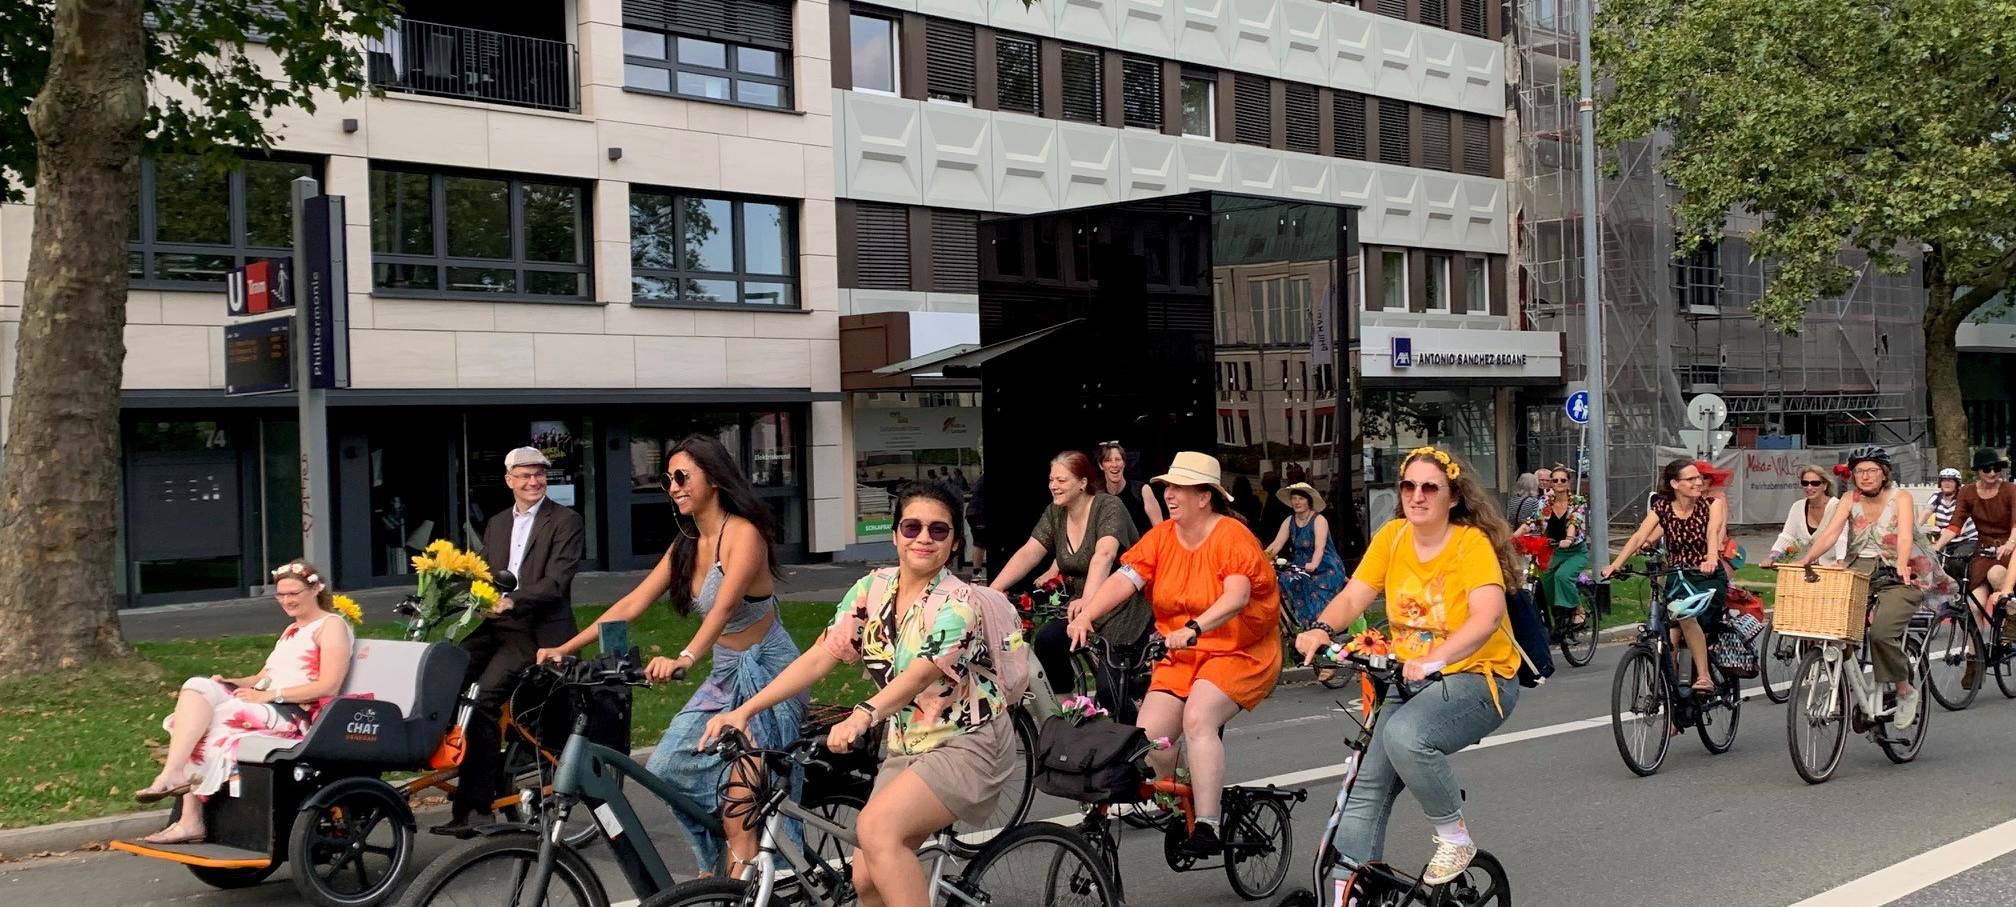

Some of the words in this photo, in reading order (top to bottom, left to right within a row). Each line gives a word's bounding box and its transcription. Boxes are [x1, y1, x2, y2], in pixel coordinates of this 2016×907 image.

[228, 271, 242, 311] U
[312, 271, 322, 376] Philharmonie
[1418, 352, 1455, 365] ANTONIO
[1457, 353, 1495, 365] SANCHEZ
[1496, 353, 1527, 365] SEOANE
[204, 430, 226, 448] 74
[347, 722, 379, 735] CHAT
